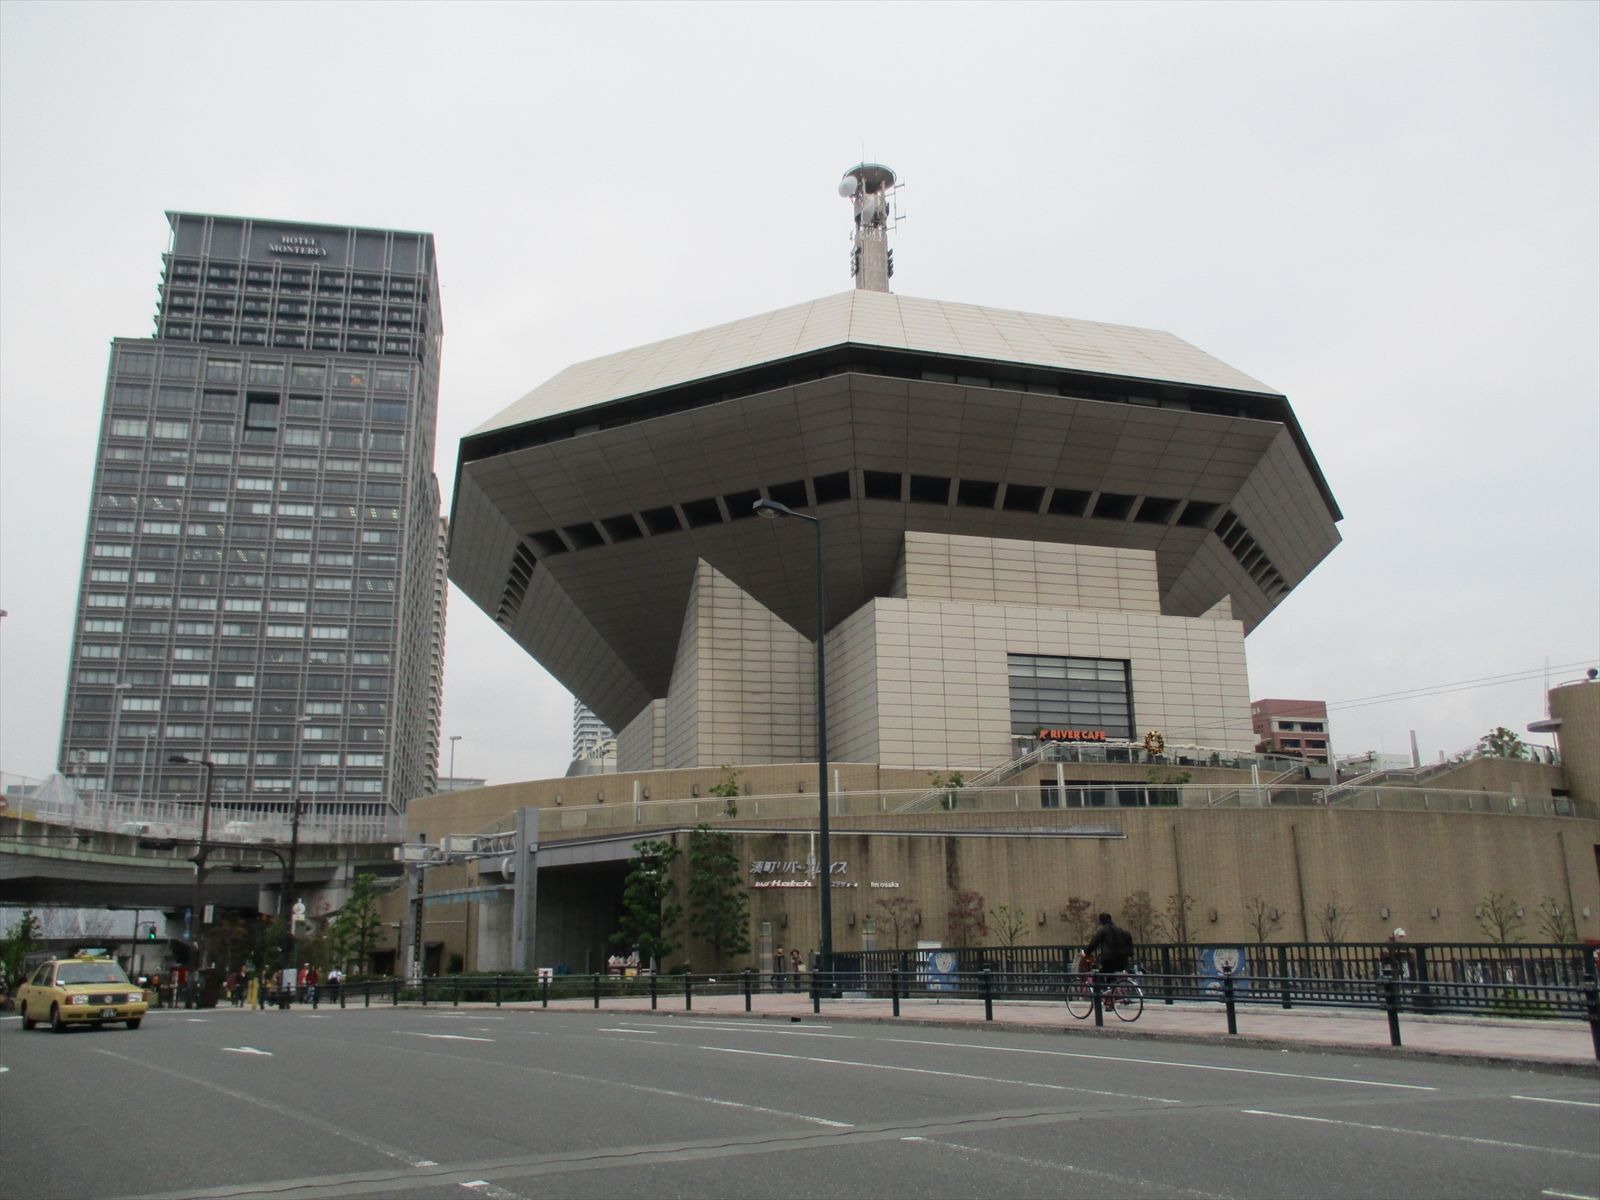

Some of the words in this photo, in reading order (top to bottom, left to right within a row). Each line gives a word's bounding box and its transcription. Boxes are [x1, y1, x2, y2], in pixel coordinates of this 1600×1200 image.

[281, 235, 317, 246] HOTEL
[268, 244, 328, 256] MONTEREY
[1050, 729, 1080, 739] RIVER
[1081, 730, 1106, 740] CAFE
[880, 881, 900, 889] osaka
